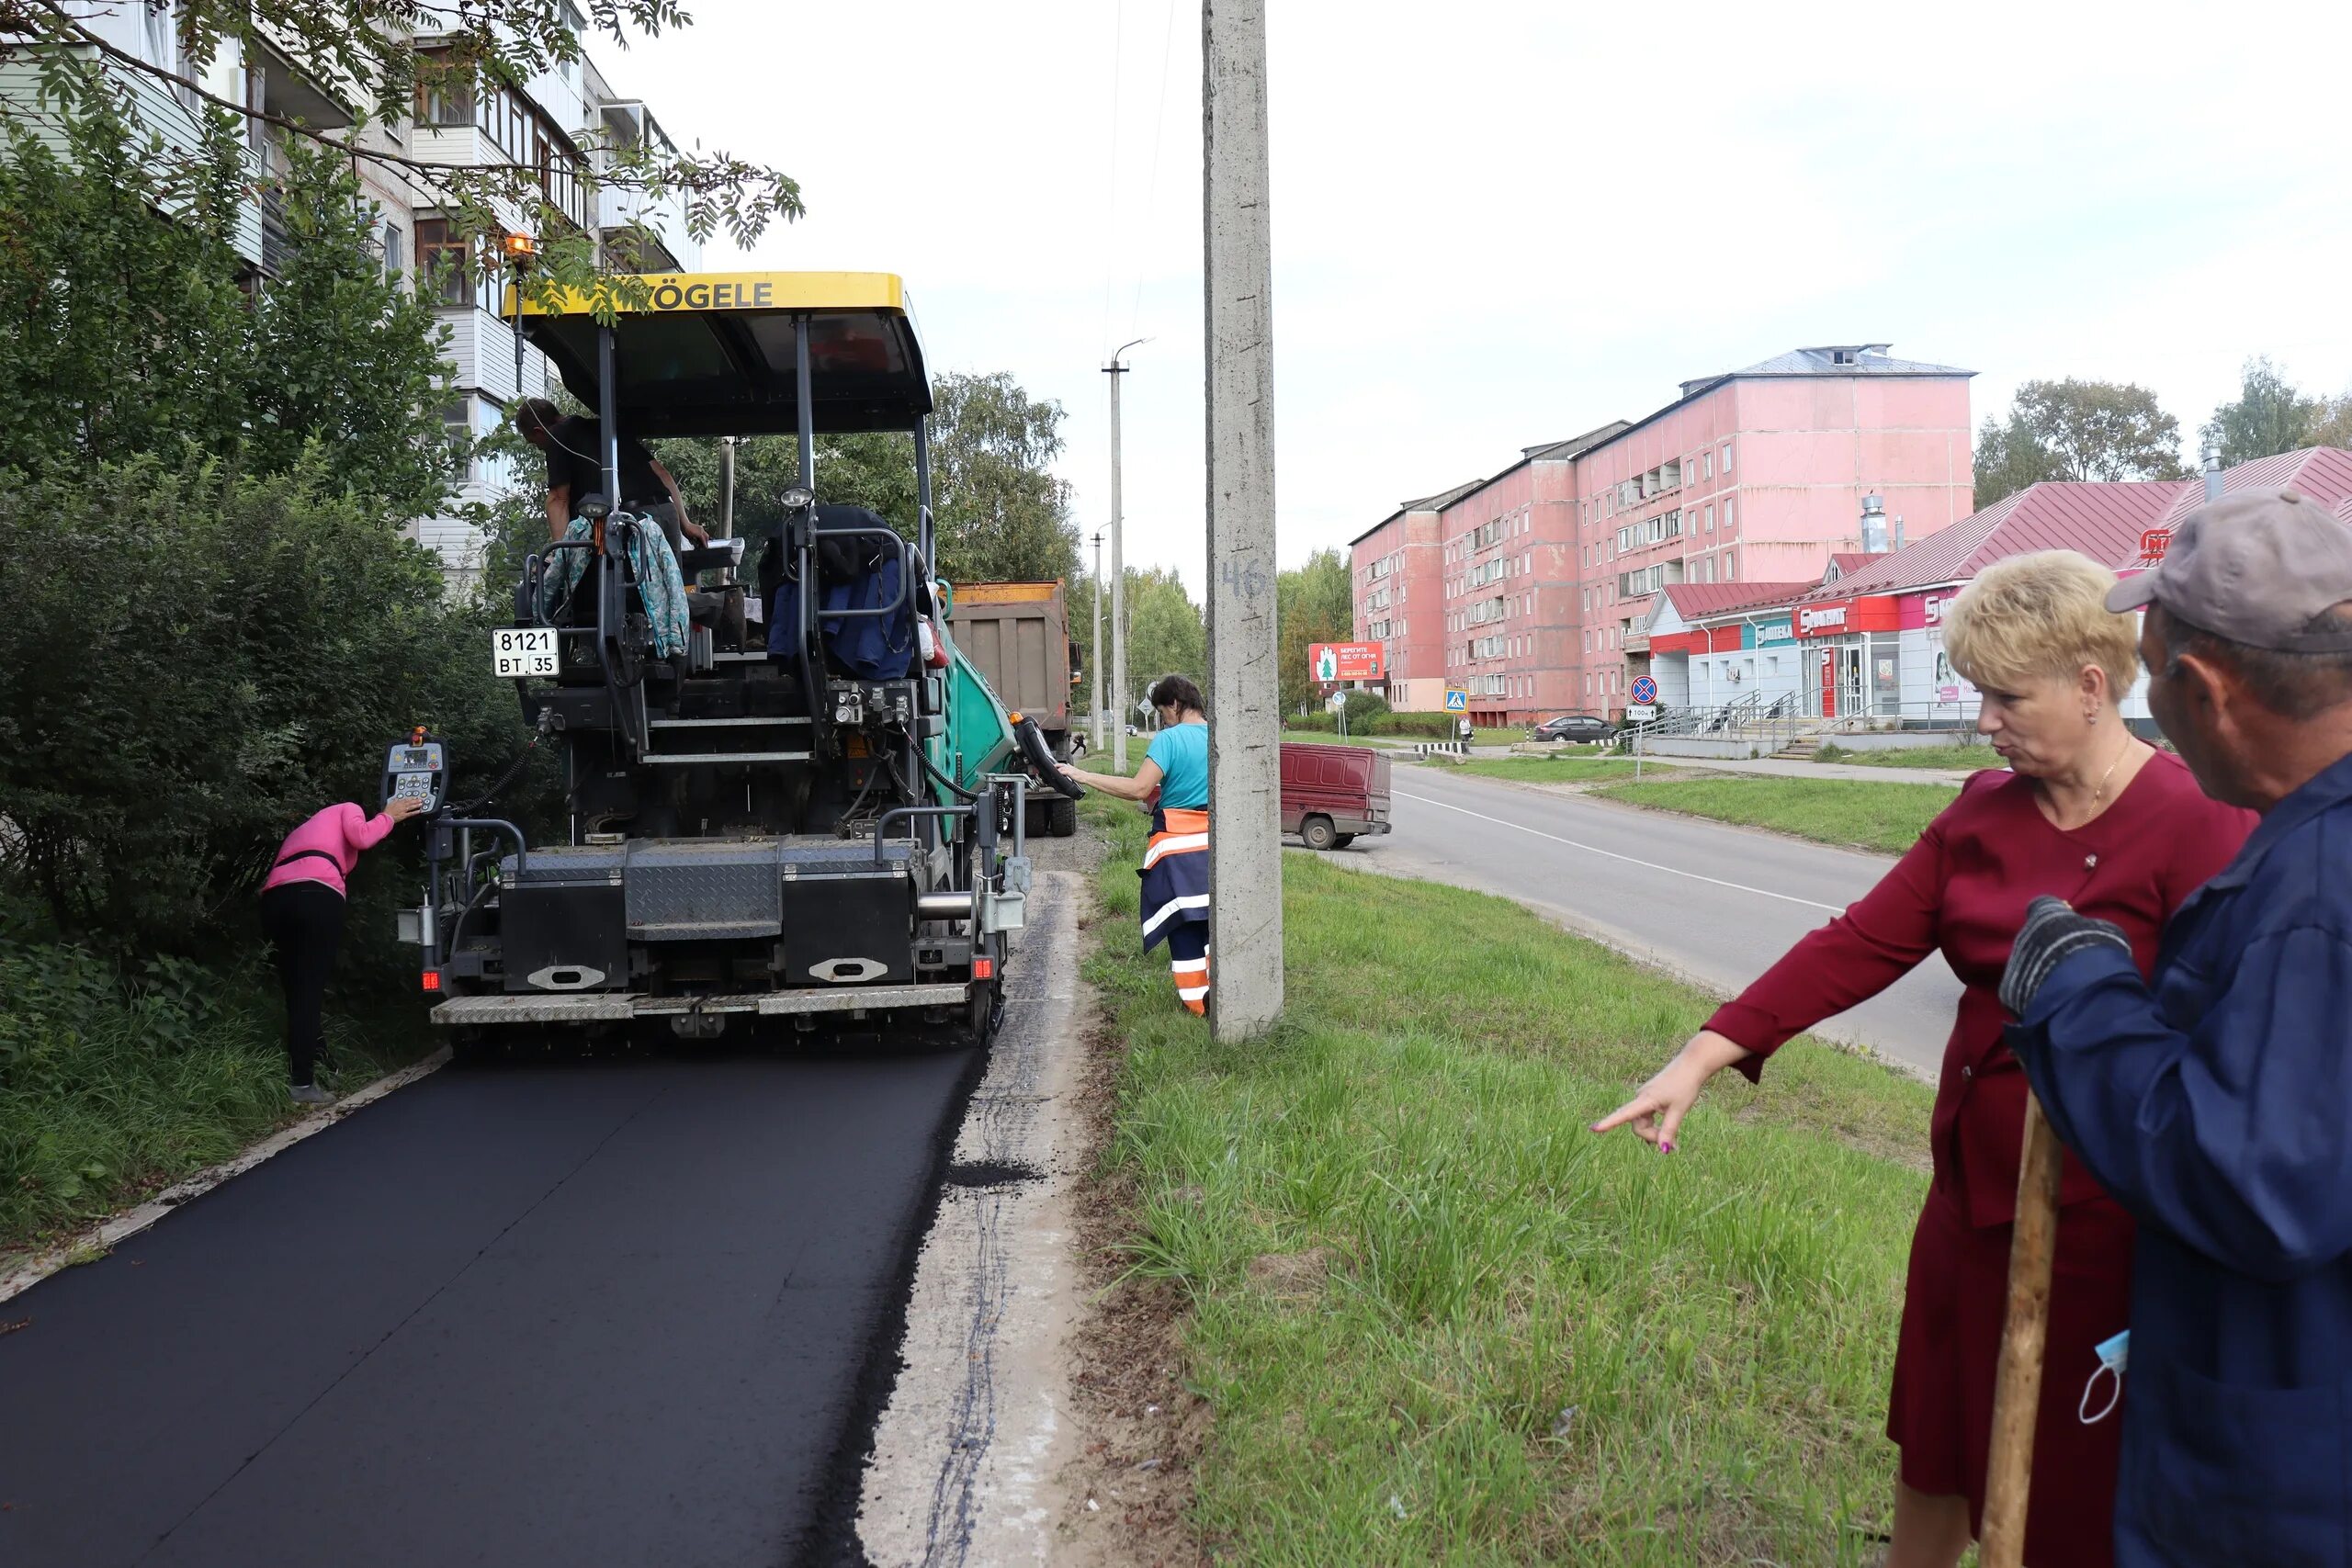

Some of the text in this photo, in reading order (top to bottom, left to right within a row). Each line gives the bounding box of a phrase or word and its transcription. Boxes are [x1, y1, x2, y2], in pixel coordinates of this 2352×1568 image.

[649, 278, 772, 310] ÖGELE
[1223, 558, 1267, 597] 46
[502, 633, 548, 650] 8121
[1764, 625, 1792, 641] АПТЕКА
[535, 658, 552, 671] 35
